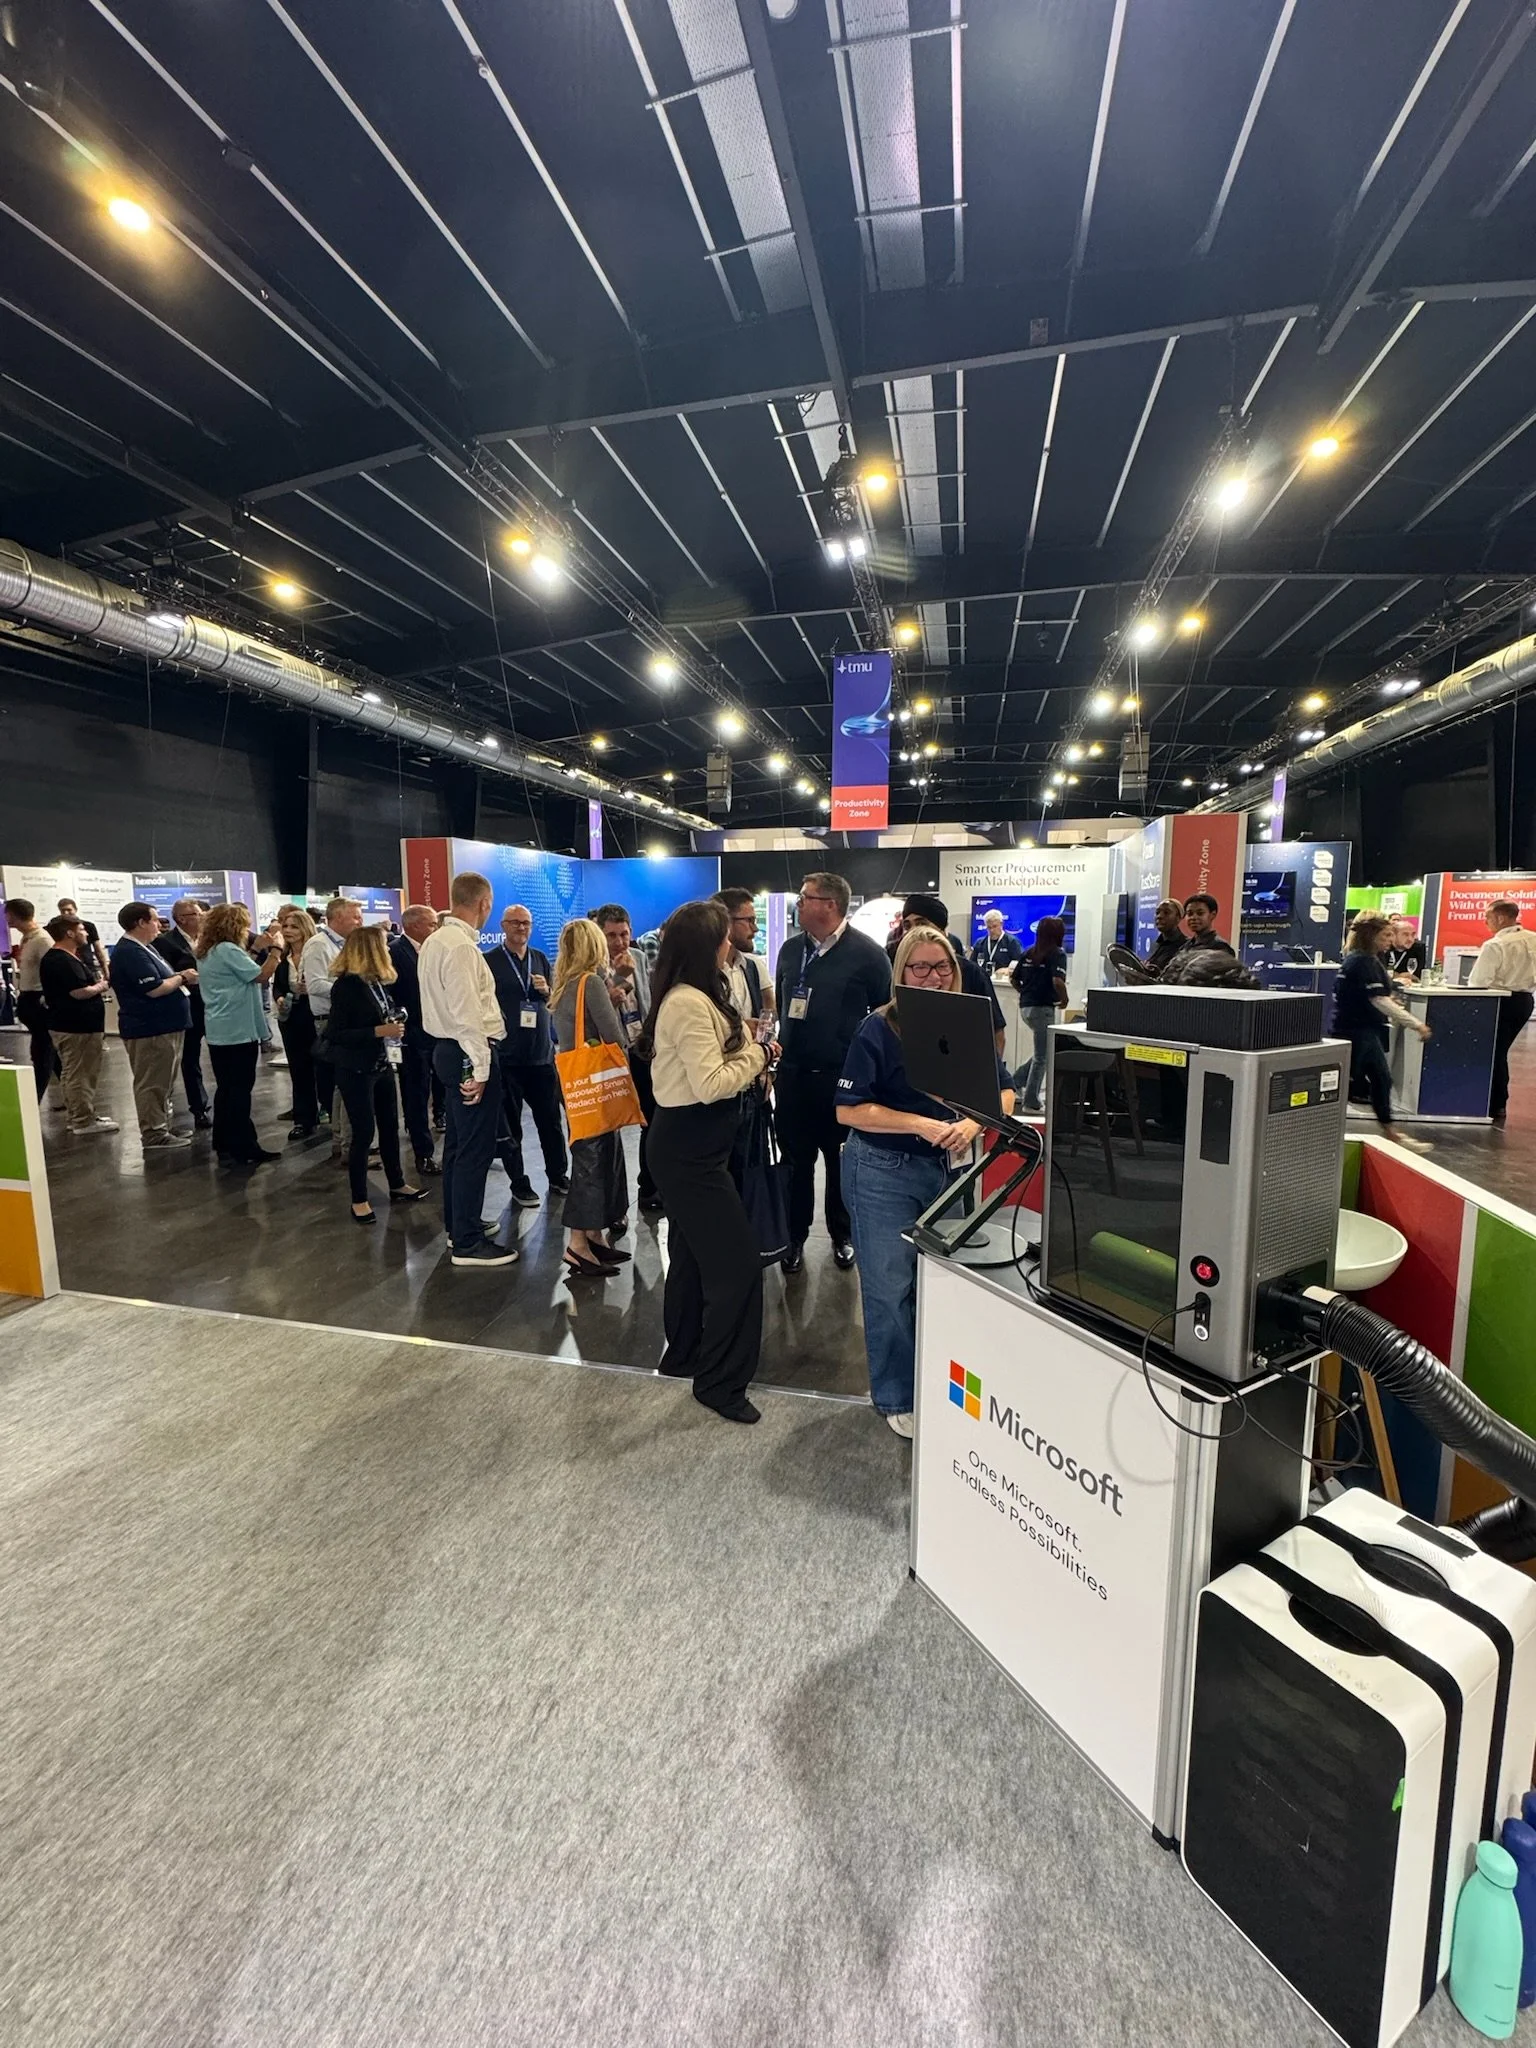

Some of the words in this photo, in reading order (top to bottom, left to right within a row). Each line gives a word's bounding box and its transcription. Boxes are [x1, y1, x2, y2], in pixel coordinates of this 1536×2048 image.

[834, 798, 886, 808] Productivity
[848, 809, 870, 817] Zone
[1199, 839, 1211, 866] Zone
[955, 863, 1003, 874] Smarter
[1005, 863, 1087, 874] Procurement
[135, 876, 167, 886] hexnode
[181, 875, 213, 885] hexnode
[955, 876, 981, 887] with
[984, 875, 1061, 888] Marketplace
[1449, 890, 1505, 900] Document
[1506, 889, 1536, 899] Soluti
[1449, 901, 1475, 910] With
[1448, 911, 1476, 920] From
[573, 1077, 589, 1089] your
[836, 1078, 854, 1090] mu
[566, 1084, 603, 1100] exposed?
[567, 1098, 596, 1110] Redact
[597, 1094, 612, 1103] can
[989, 1395, 1124, 1517] Microsoft
[968, 1450, 997, 1483] One
[1002, 1475, 1083, 1553] Microsoft.
[953, 1459, 1005, 1514] Endless
[1009, 1506, 1108, 1601] Possibilities
